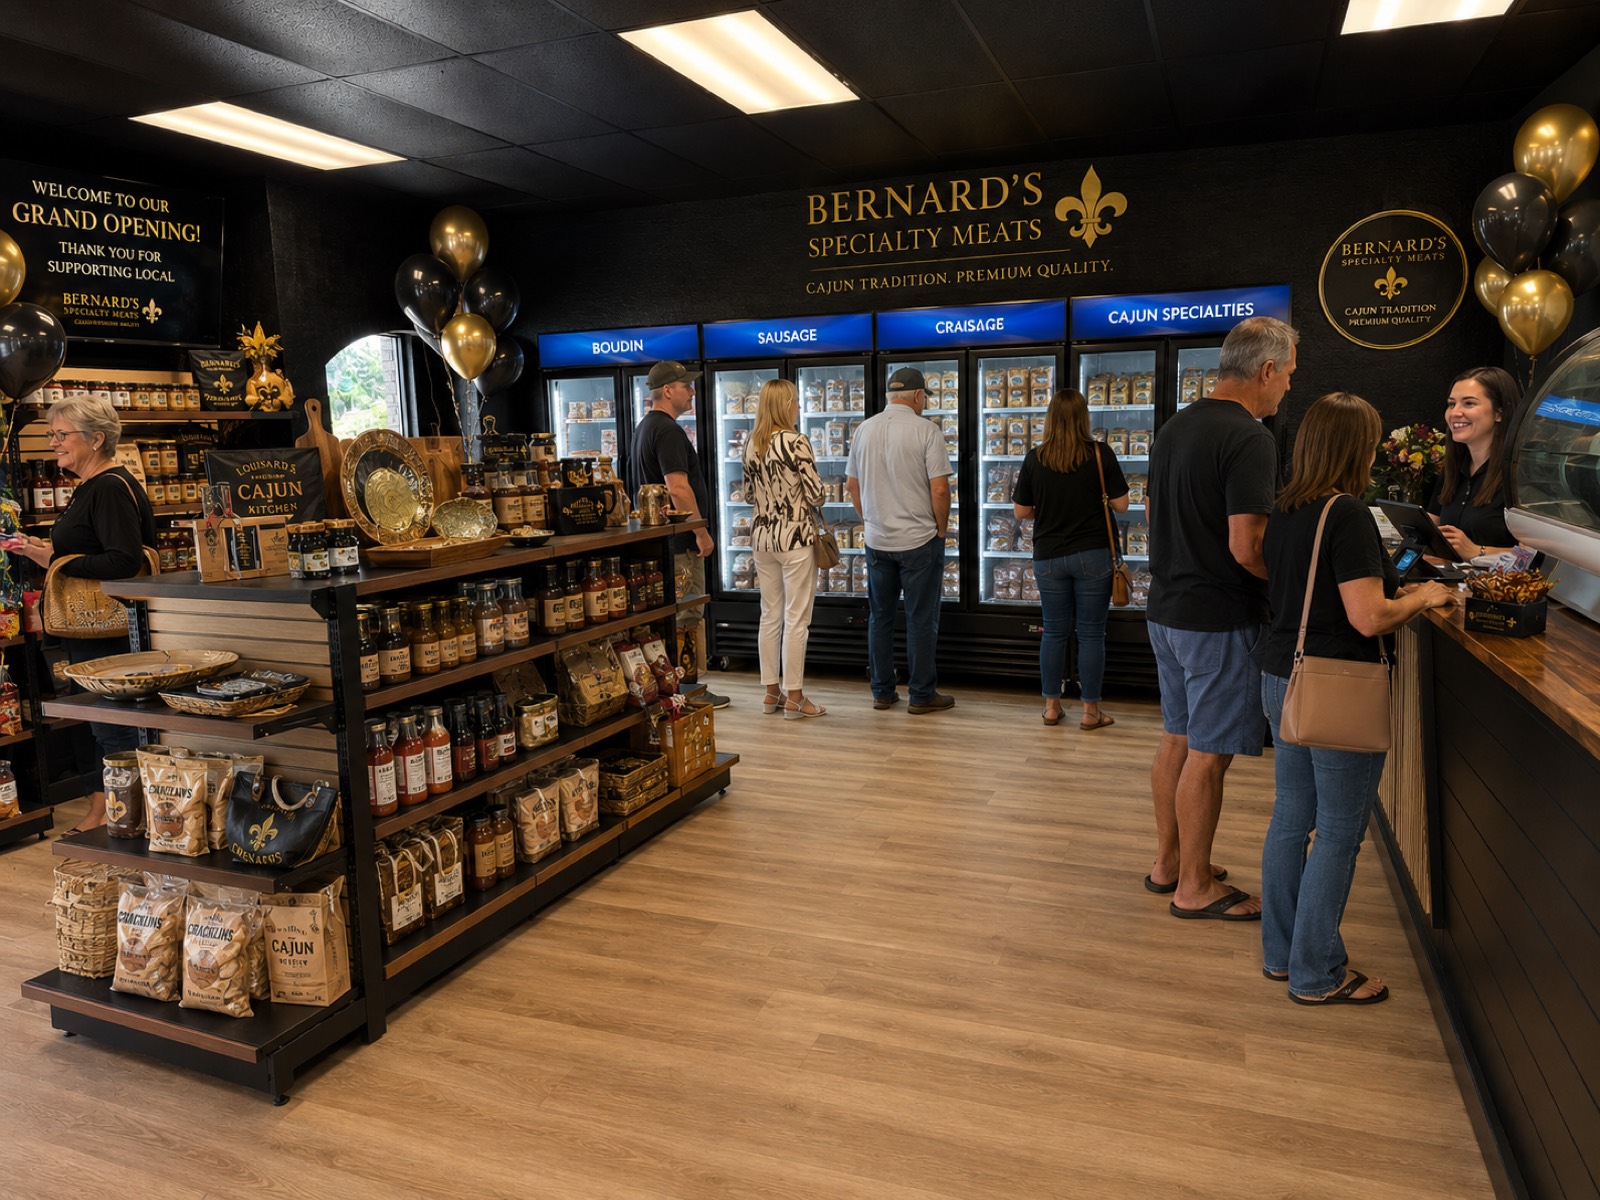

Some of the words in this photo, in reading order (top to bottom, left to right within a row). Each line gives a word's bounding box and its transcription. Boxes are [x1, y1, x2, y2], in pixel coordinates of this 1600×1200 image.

[31, 179, 112, 205] WELCOME
[115, 192, 136, 208] TO
[139, 197, 170, 213] OUR
[807, 171, 1043, 225] BERNARD'S
[12, 202, 97, 231] GRAND
[103, 212, 201, 243] OPENING!
[808, 227, 943, 258] SPECIALTY
[952, 219, 1042, 246] MEATS
[1342, 236, 1447, 256] BERNARD'S
[58, 241, 105, 257] THANK
[108, 246, 136, 260] YOU
[138, 249, 162, 263] FOR
[1341, 255, 1402, 267] SPECIALTY
[1407, 252, 1445, 262] MEATS
[47, 260, 132, 279] SUPPORTING
[135, 269, 176, 283] LOCAL
[806, 279, 854, 296] CAJUN
[860, 271, 952, 291] TRADITION.
[956, 265, 1032, 284] PREMIUM
[1036, 259, 1114, 279] QUALITY.
[63, 292, 140, 309] BERNARD'S
[1344, 307, 1378, 317] CAJUN
[1380, 303, 1437, 314] TRADITION
[1108, 307, 1158, 325] CAJUN
[1162, 301, 1255, 322] SPECIALTIES
[1348, 317, 1390, 327] PREMIUM
[1391, 315, 1431, 326] QUALITY
[757, 328, 818, 345] SAUSAGE
[592, 339, 644, 355] BOUDIN
[237, 481, 303, 502] CAJUN
[248, 502, 298, 515] KITCHEN
[271, 939, 315, 957] CAJUN
